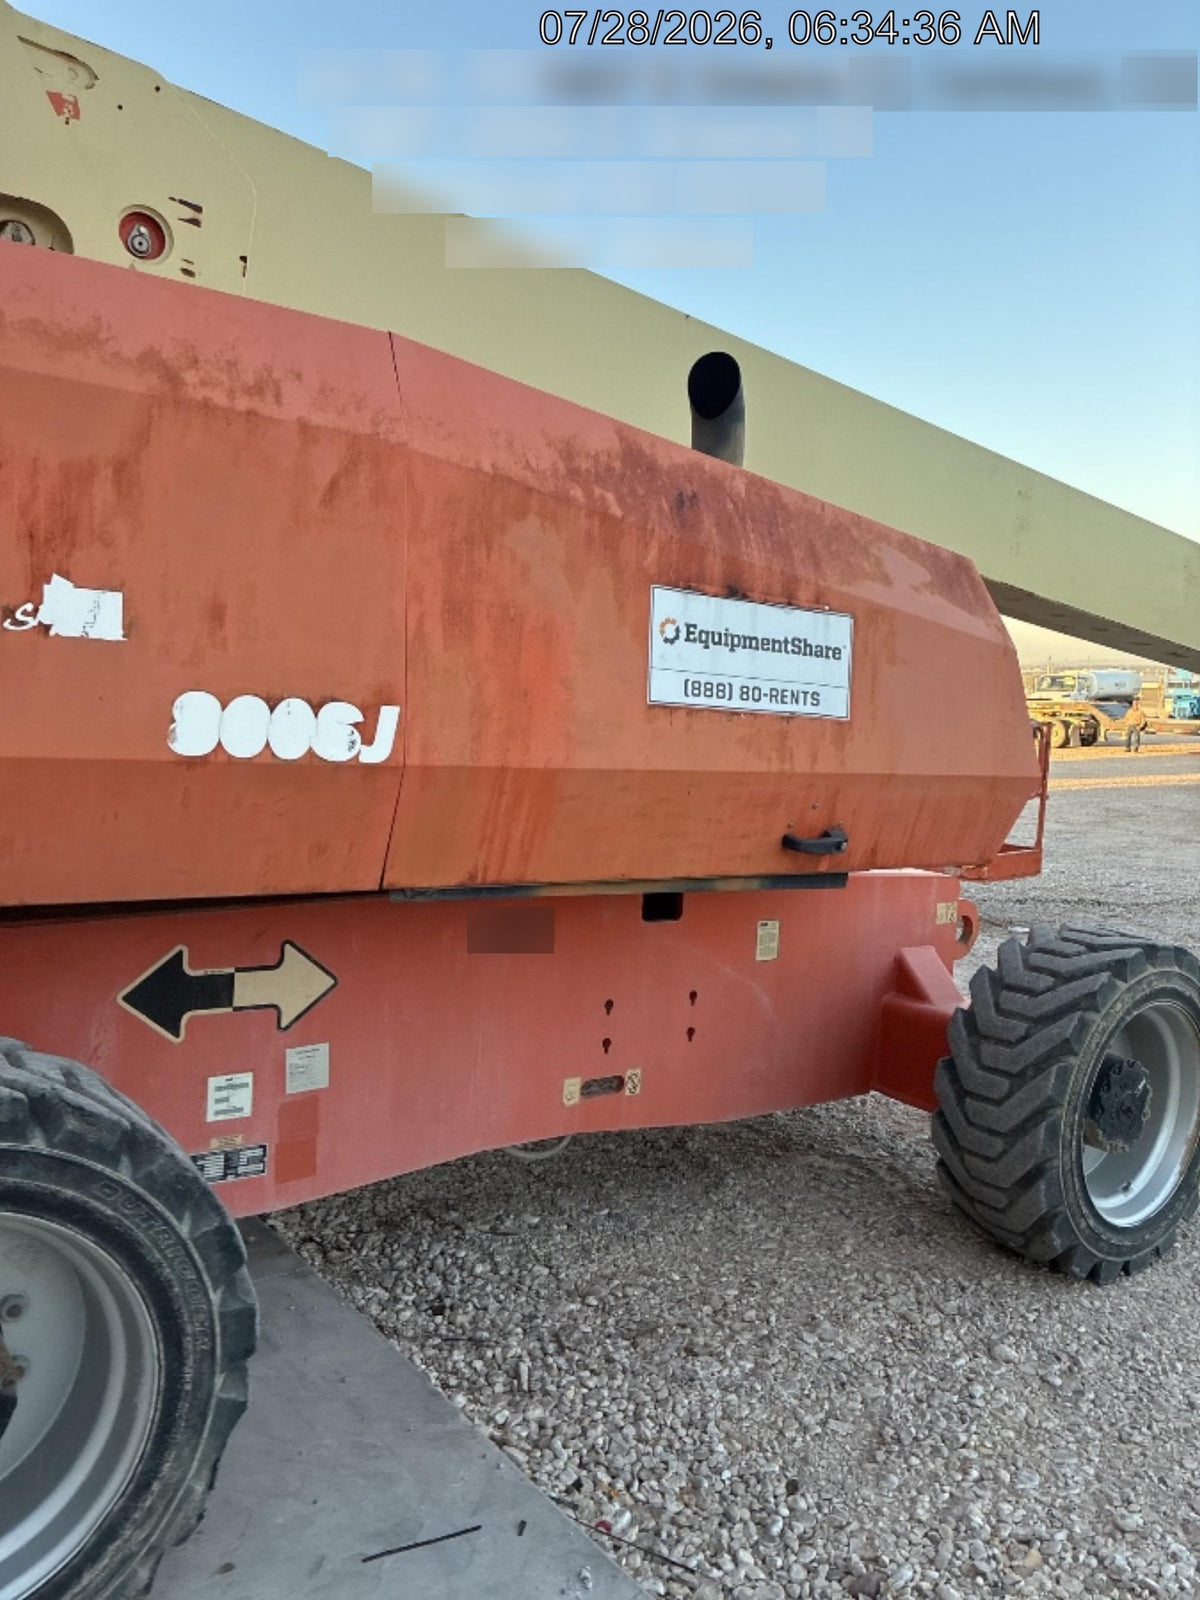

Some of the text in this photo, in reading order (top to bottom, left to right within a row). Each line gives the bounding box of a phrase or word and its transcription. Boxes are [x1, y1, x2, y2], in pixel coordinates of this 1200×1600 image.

[684, 622, 842, 660] EquipmentShare
[683, 678, 821, 707] (888) 80-RENTS
